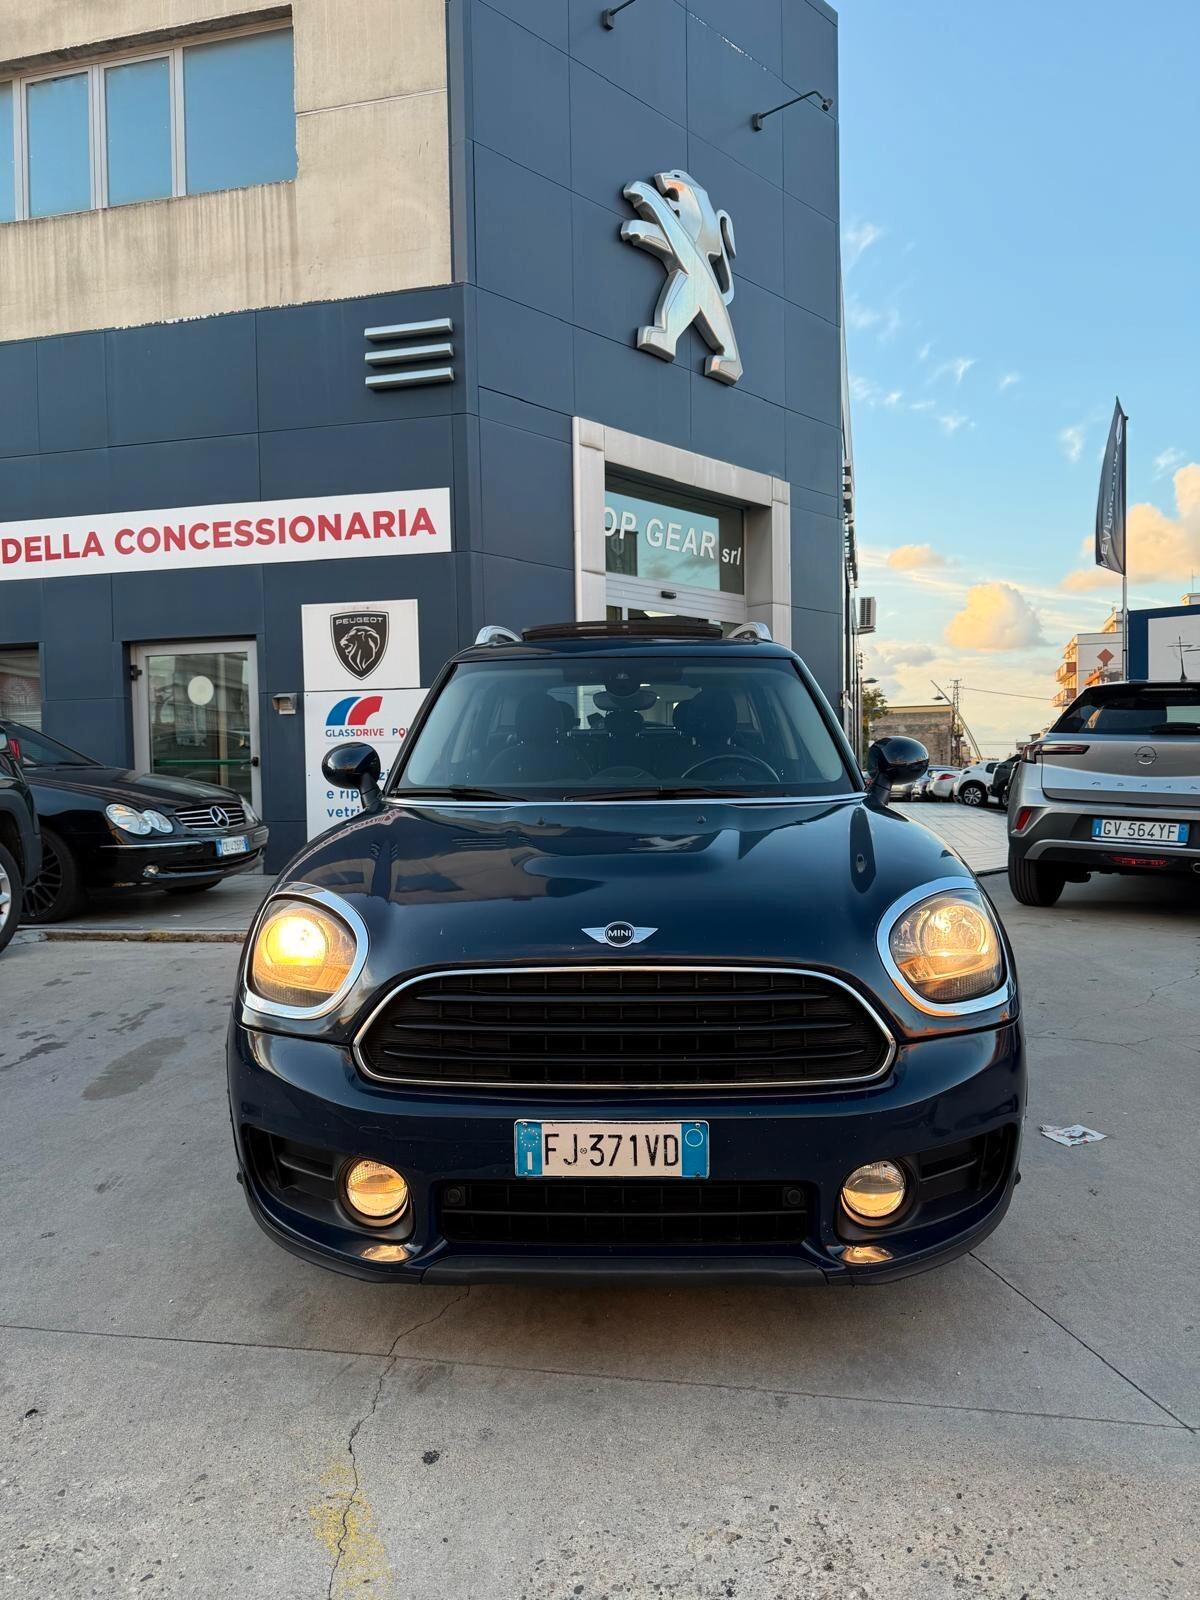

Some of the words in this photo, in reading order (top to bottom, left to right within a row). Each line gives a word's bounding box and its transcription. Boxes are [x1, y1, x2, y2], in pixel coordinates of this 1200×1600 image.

[1, 531, 105, 564] DELLA
[114, 507, 437, 555] CONCESSIONARIA
[604, 507, 637, 539] OP
[646, 518, 716, 559] GEAR
[721, 547, 742, 565] srl
[335, 616, 384, 625] PEUGEOT
[325, 728, 385, 737] GLASSDRIVE
[326, 790, 334, 799] e
[340, 790, 359, 801] rip
[607, 929, 632, 937] MINI
